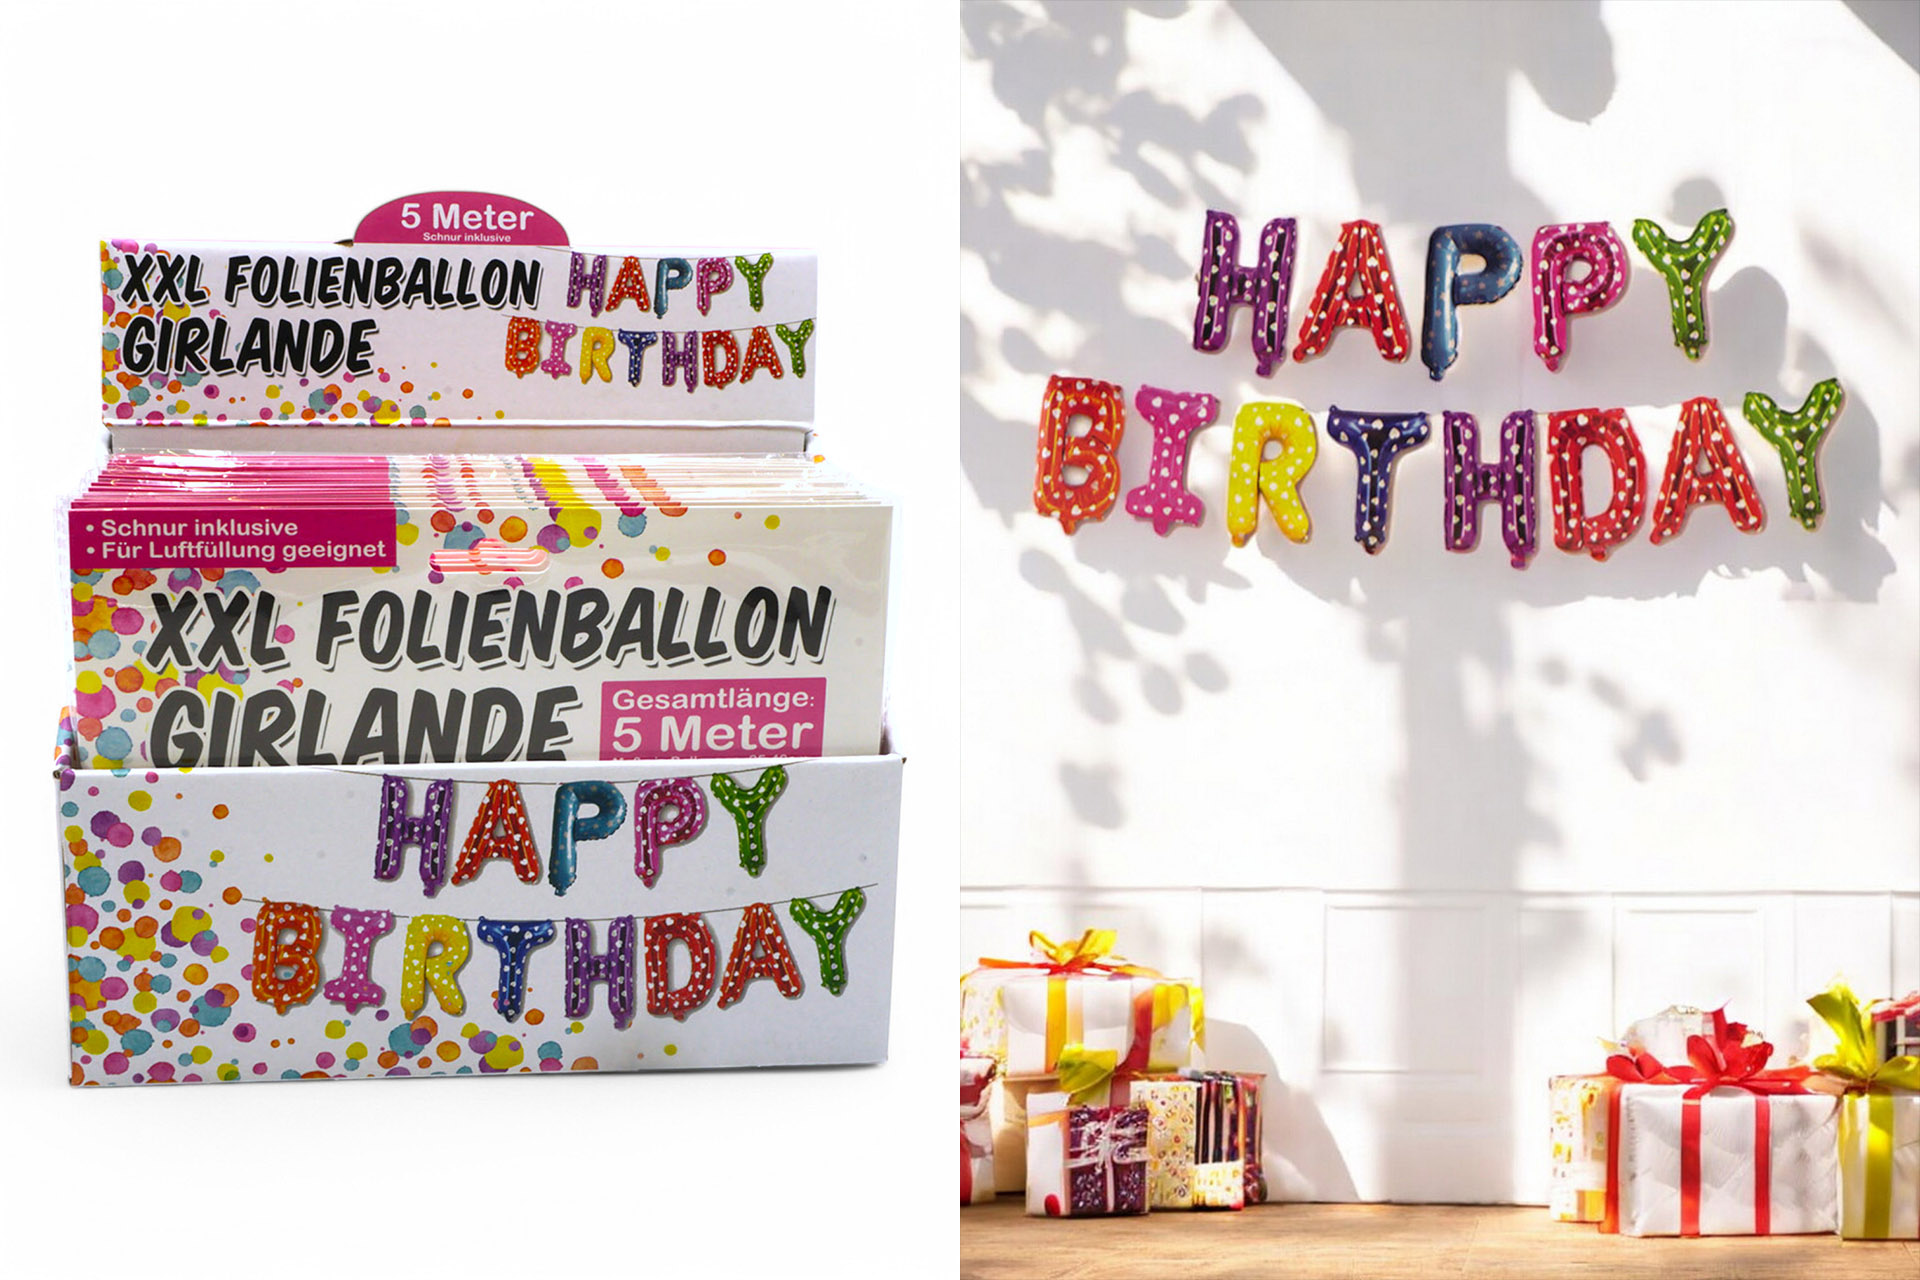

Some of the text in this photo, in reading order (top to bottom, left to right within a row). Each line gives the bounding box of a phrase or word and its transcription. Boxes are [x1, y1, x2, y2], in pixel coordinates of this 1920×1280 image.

[401, 203, 535, 230] 5 Meter
[423, 232, 511, 243] Schnur inklusive
[119, 253, 544, 312] XXL FOLIENBALLON
[567, 252, 774, 317] HAPPY
[1192, 208, 1734, 381] HAPPY
[120, 317, 379, 379] GIRLANDE
[504, 316, 816, 393] BIRTHDAY
[1031, 377, 1845, 568] BIRTHDAY
[101, 518, 299, 537] Schnur inklusive
[102, 540, 387, 561] Für Luftfüllung geeignet
[145, 585, 837, 673] XXL FOLIENBALLON
[149, 684, 583, 767] GIRLANDE
[612, 688, 815, 713] Gesamtlänge:
[612, 715, 814, 753] 5 Meter
[373, 764, 790, 898] HAPPY
[252, 884, 867, 1031] BIRTHDAY
